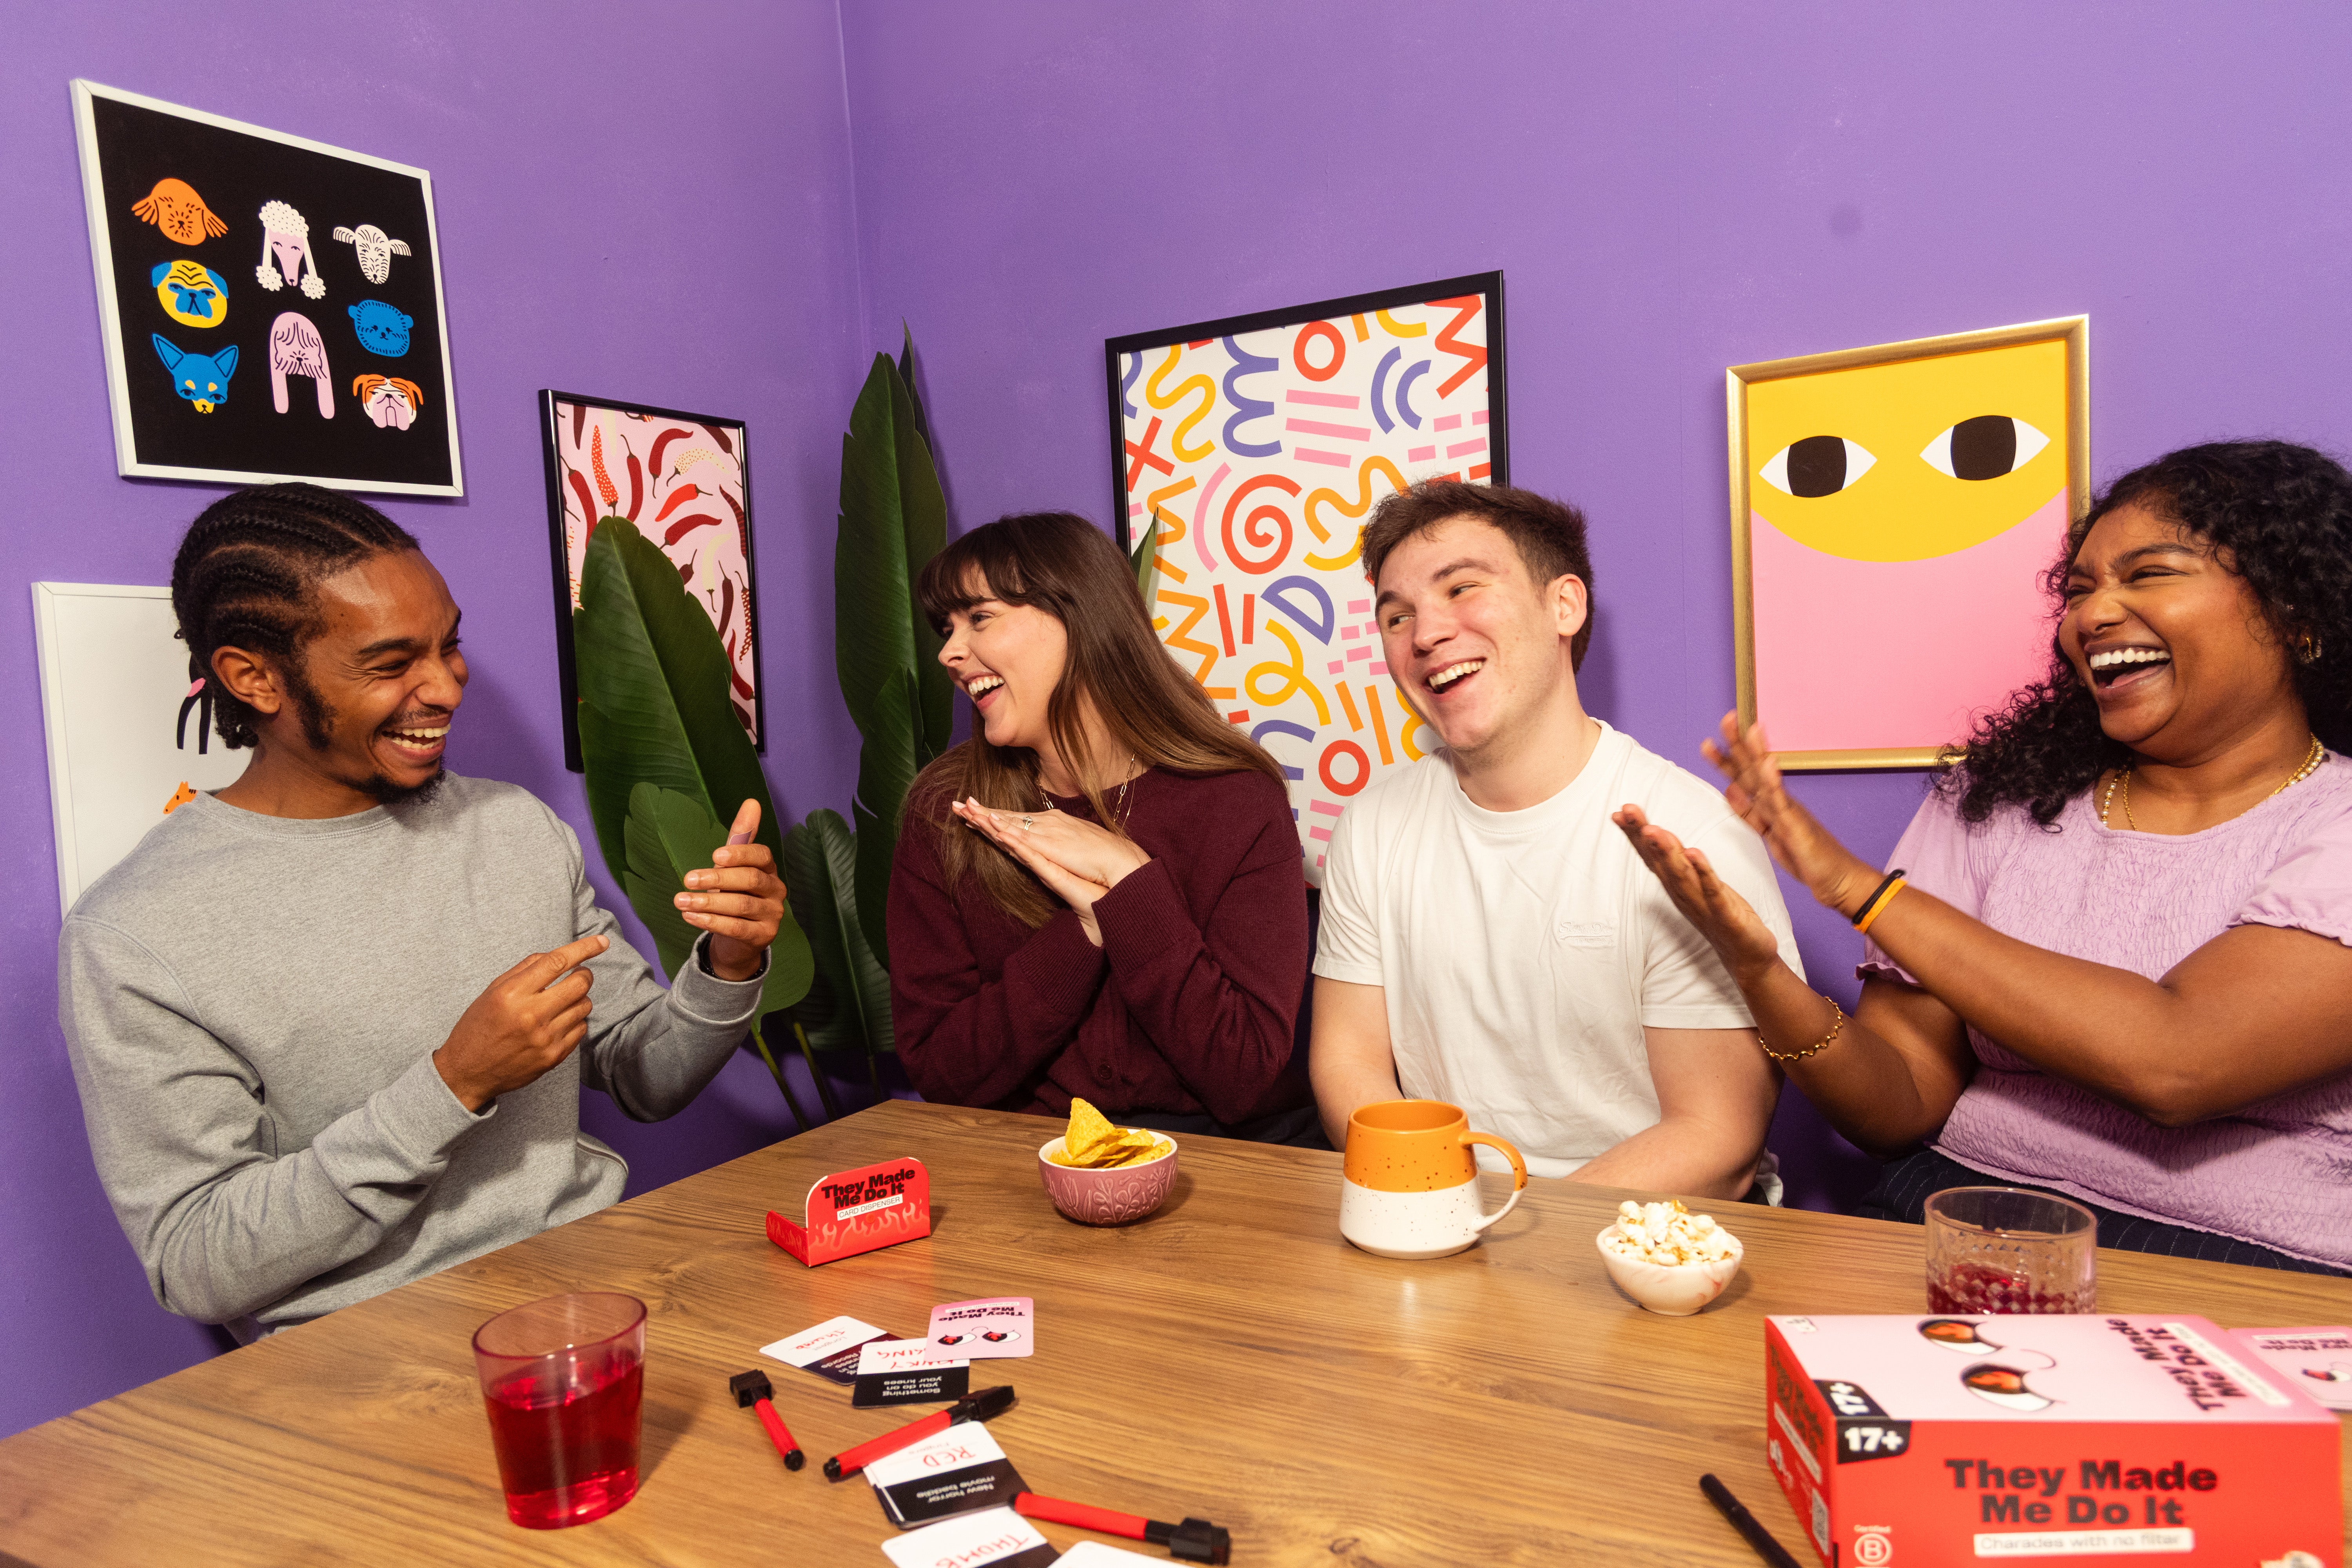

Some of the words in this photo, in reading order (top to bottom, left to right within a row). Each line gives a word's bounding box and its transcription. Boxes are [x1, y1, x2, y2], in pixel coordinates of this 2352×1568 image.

[822, 1181, 865, 1199] They
[869, 1168, 915, 1189] Made
[834, 1194, 860, 1209] Me
[864, 1187, 887, 1201] Do
[890, 1181, 905, 1195] It
[839, 1207, 859, 1218] CARD
[860, 1196, 900, 1212] DISPENSER
[938, 1313, 982, 1322] Made
[882, 1387, 941, 1397] Something
[1830, 1382, 1868, 1416] 17+
[1844, 1427, 1904, 1452] 17+
[922, 1445, 976, 1467] RED
[960, 1475, 995, 1488] movie
[1945, 1458, 2065, 1497] They
[2080, 1460, 2218, 1492] Made
[926, 1489, 965, 1504] horror
[966, 1483, 995, 1495] New
[1981, 1495, 2052, 1524] Me
[2067, 1495, 2129, 1525] Do
[2145, 1496, 2183, 1525] It
[1980, 1532, 2064, 1550] Charades
[2070, 1531, 2107, 1548] with
[2113, 1534, 2134, 1546] no
[2139, 1530, 2180, 1546] filter
